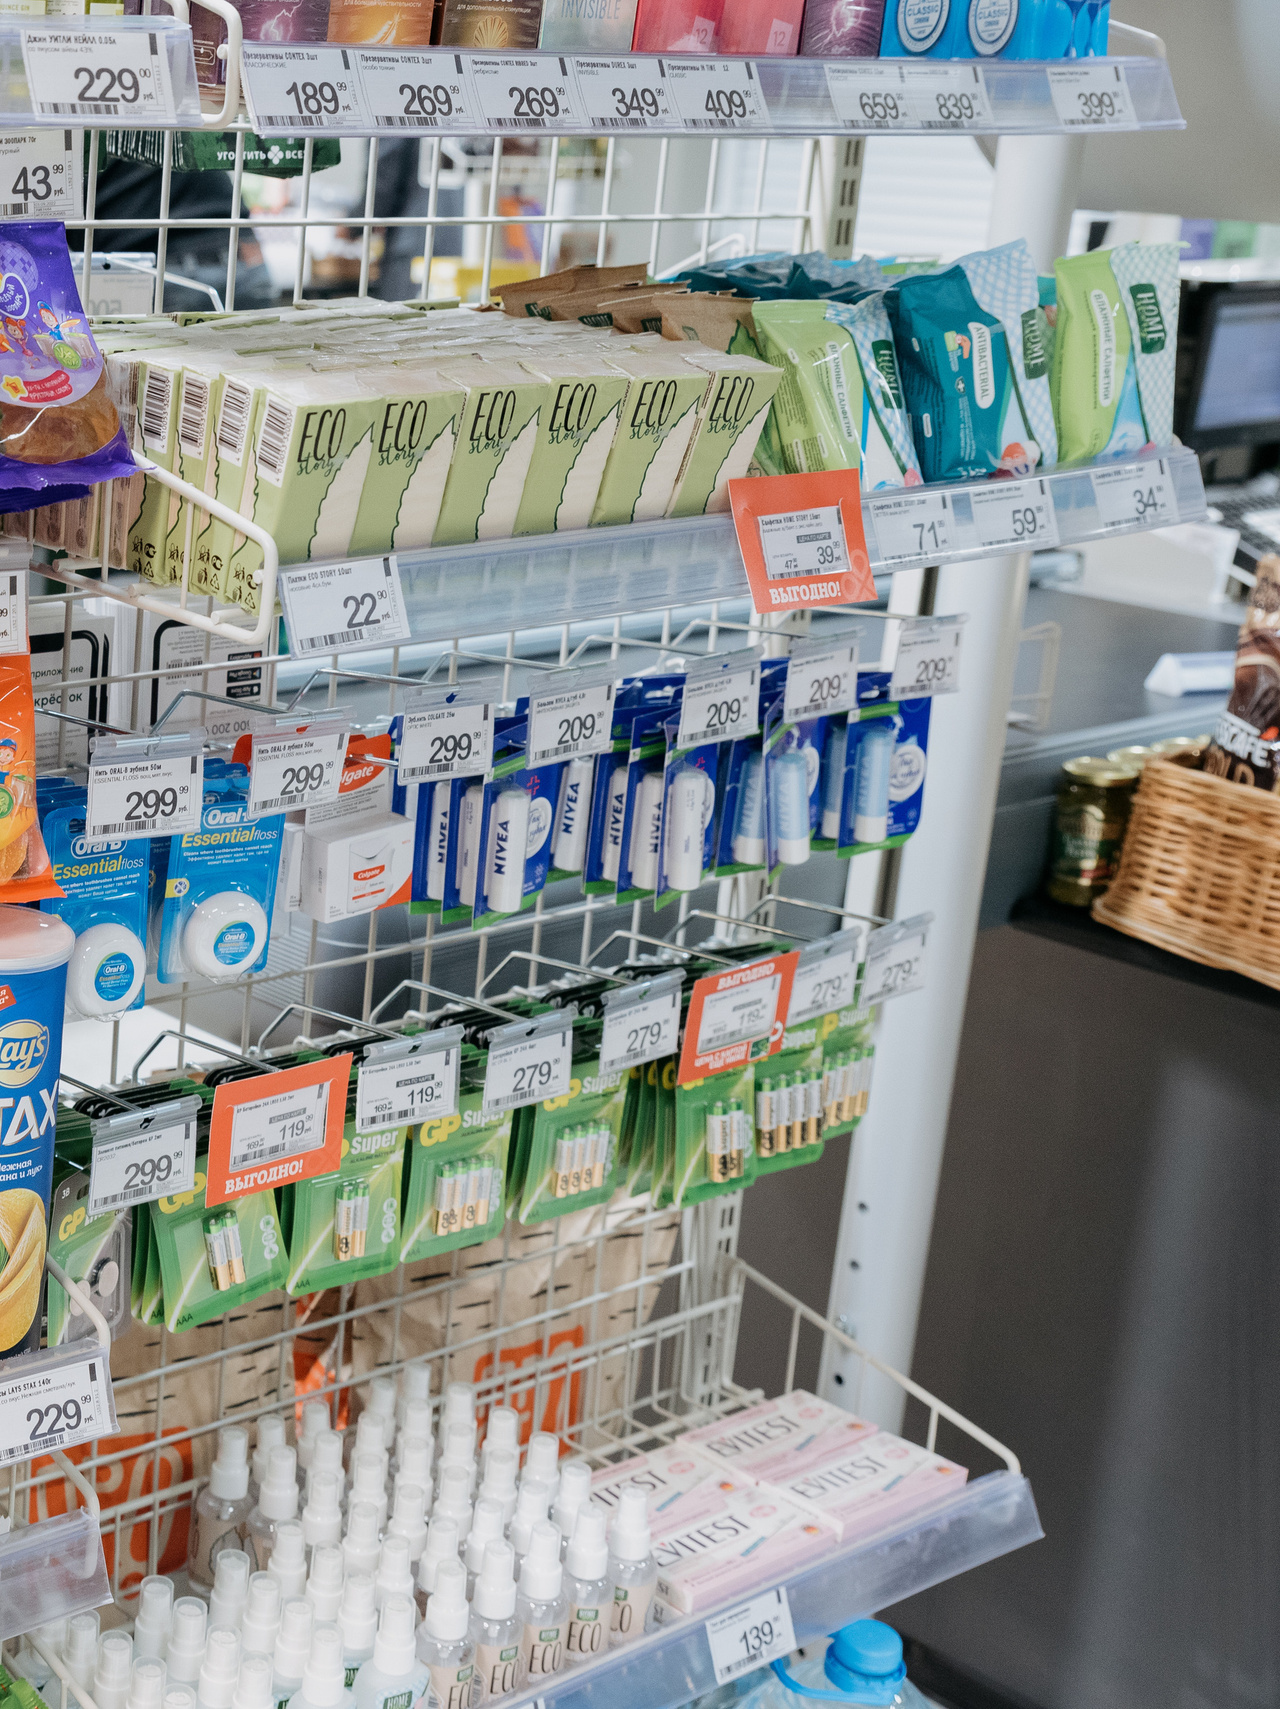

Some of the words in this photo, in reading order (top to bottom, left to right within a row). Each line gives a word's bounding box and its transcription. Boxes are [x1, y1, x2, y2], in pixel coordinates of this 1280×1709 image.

[456, 3, 468, 11] для
[696, 28, 708, 45] 12
[773, 30, 785, 46] 12
[73, 66, 140, 103] 229
[139, 67, 152, 79] 00
[286, 81, 340, 115] 189
[399, 84, 453, 117] 269
[509, 86, 559, 118] 269
[612, 87, 660, 117] 349
[705, 89, 747, 119] 409
[859, 92, 901, 120] 659
[936, 93, 974, 121] 839
[1077, 91, 1115, 118] 399
[11, 165, 53, 202] 43
[1136, 291, 1165, 343] HOME
[973, 325, 989, 399] ANTIBACTERIAL
[549, 383, 597, 433] ECO
[630, 379, 677, 428] ECO
[709, 376, 756, 422] ECO
[1132, 487, 1159, 515] 34
[913, 522, 939, 551] 71
[1012, 507, 1037, 537] 59
[785, 560, 793, 569] 47
[816, 545, 834, 564] 39
[307, 569, 318, 580] ECO
[319, 568, 336, 579] STORY
[770, 581, 842, 605] ВЫГОДНО!
[343, 592, 381, 628] 22
[377, 590, 388, 600] 90
[916, 657, 947, 685] 209
[810, 675, 842, 703] 209
[558, 712, 596, 745] 209
[707, 698, 742, 729] 209
[429, 732, 472, 765] 299
[280, 763, 324, 797] 299
[125, 787, 178, 821] 299
[561, 780, 580, 835] NIVEA
[437, 810, 450, 864] NIVEA
[493, 819, 511, 879] NIVEA
[358, 869, 381, 879] Colgate
[224, 932, 247, 942] Oral-B
[882, 960, 914, 990] 279
[811, 981, 842, 1009] 279
[626, 1025, 661, 1054] 279
[513, 1060, 551, 1093] 279
[373, 1102, 388, 1113] 169
[407, 1085, 435, 1106] 119
[279, 1119, 305, 1141] 119
[462, 1107, 507, 1128] Super
[351, 1129, 399, 1156] Super
[124, 1154, 172, 1191] 299
[225, 1159, 304, 1195] ВЫГОДНО!
[176, 1312, 194, 1327] AAA
[7, 1385, 23, 1396] LAYS
[23, 1380, 37, 1393] STAX
[37, 1377, 52, 1388] 140г
[26, 1398, 83, 1441] 229
[80, 1394, 92, 1405] 99
[740, 1621, 774, 1655] 139
[529, 1641, 563, 1675] ECO
